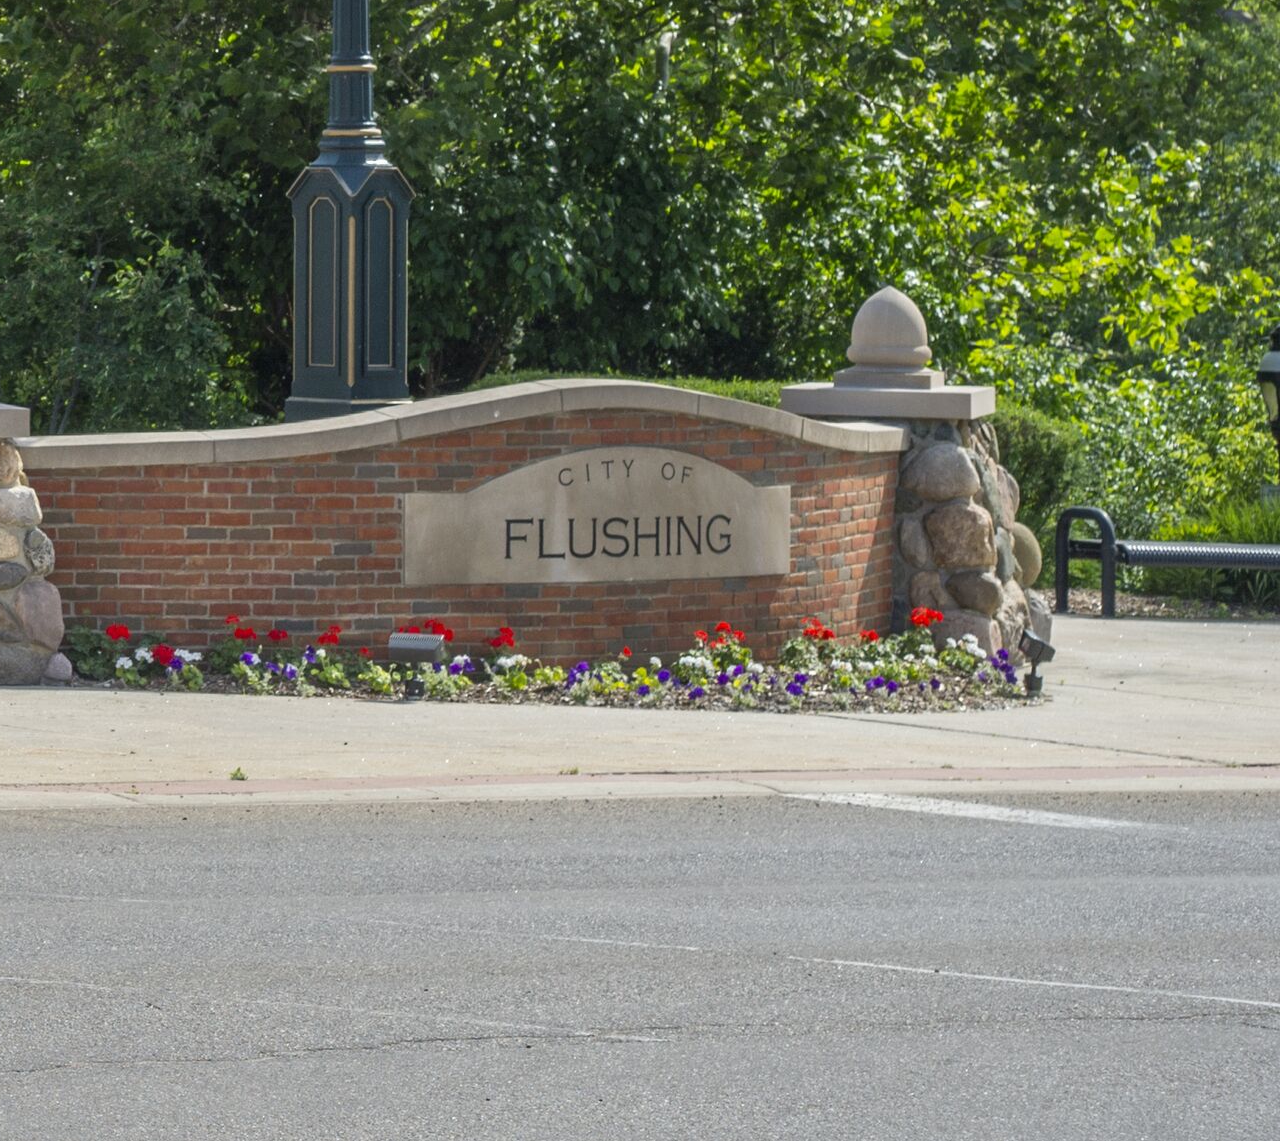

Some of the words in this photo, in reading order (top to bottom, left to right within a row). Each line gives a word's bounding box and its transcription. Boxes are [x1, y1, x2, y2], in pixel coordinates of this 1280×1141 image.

[557, 459, 635, 487] CITY
[660, 462, 695, 483] OF
[503, 514, 733, 560] FLUSHING
